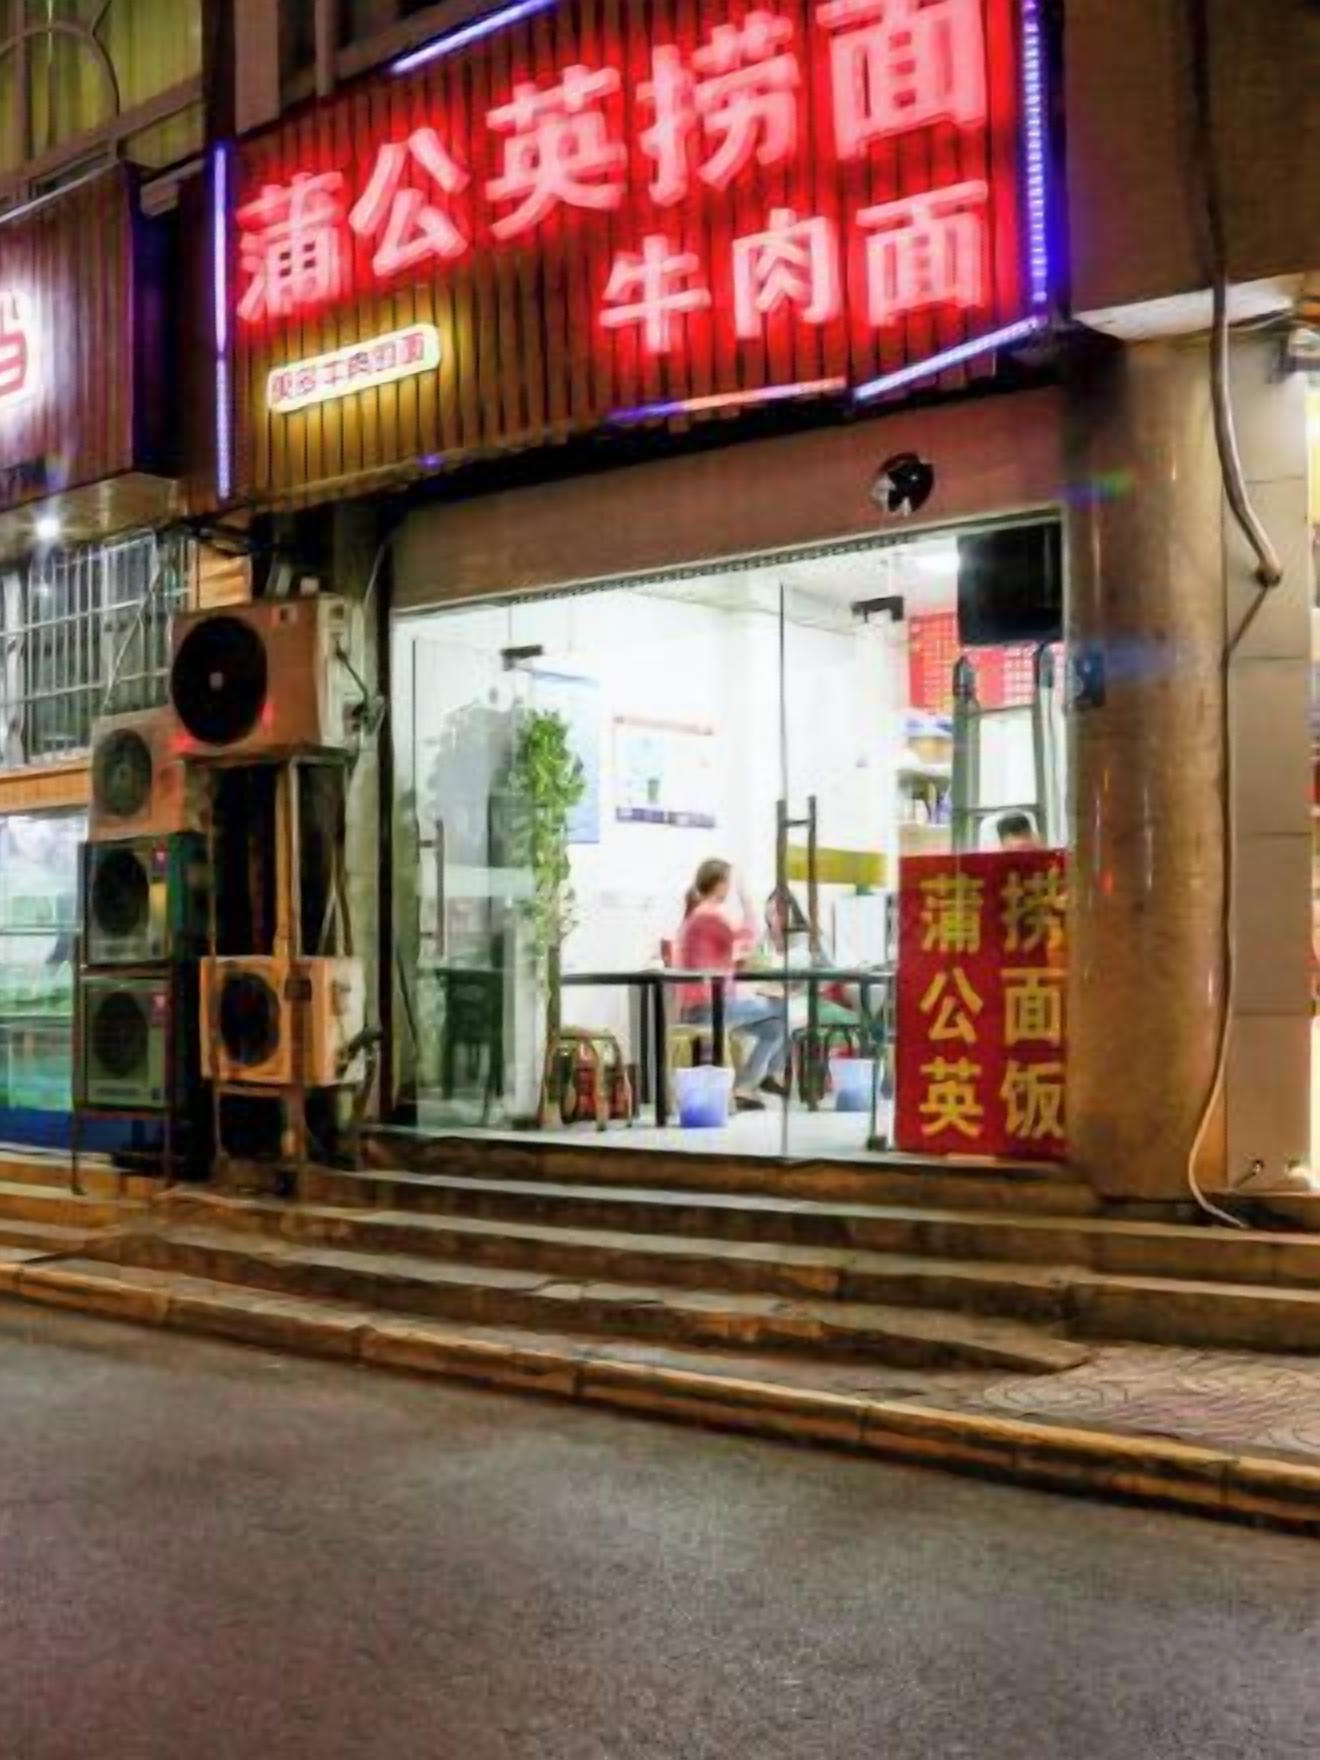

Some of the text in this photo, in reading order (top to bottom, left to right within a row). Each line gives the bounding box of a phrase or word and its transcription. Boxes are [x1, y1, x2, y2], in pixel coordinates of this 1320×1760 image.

[236, 0, 990, 323] 蒲公英捞面
[599, 179, 991, 354] 牛肉面
[919, 872, 984, 1138] 蒲公英
